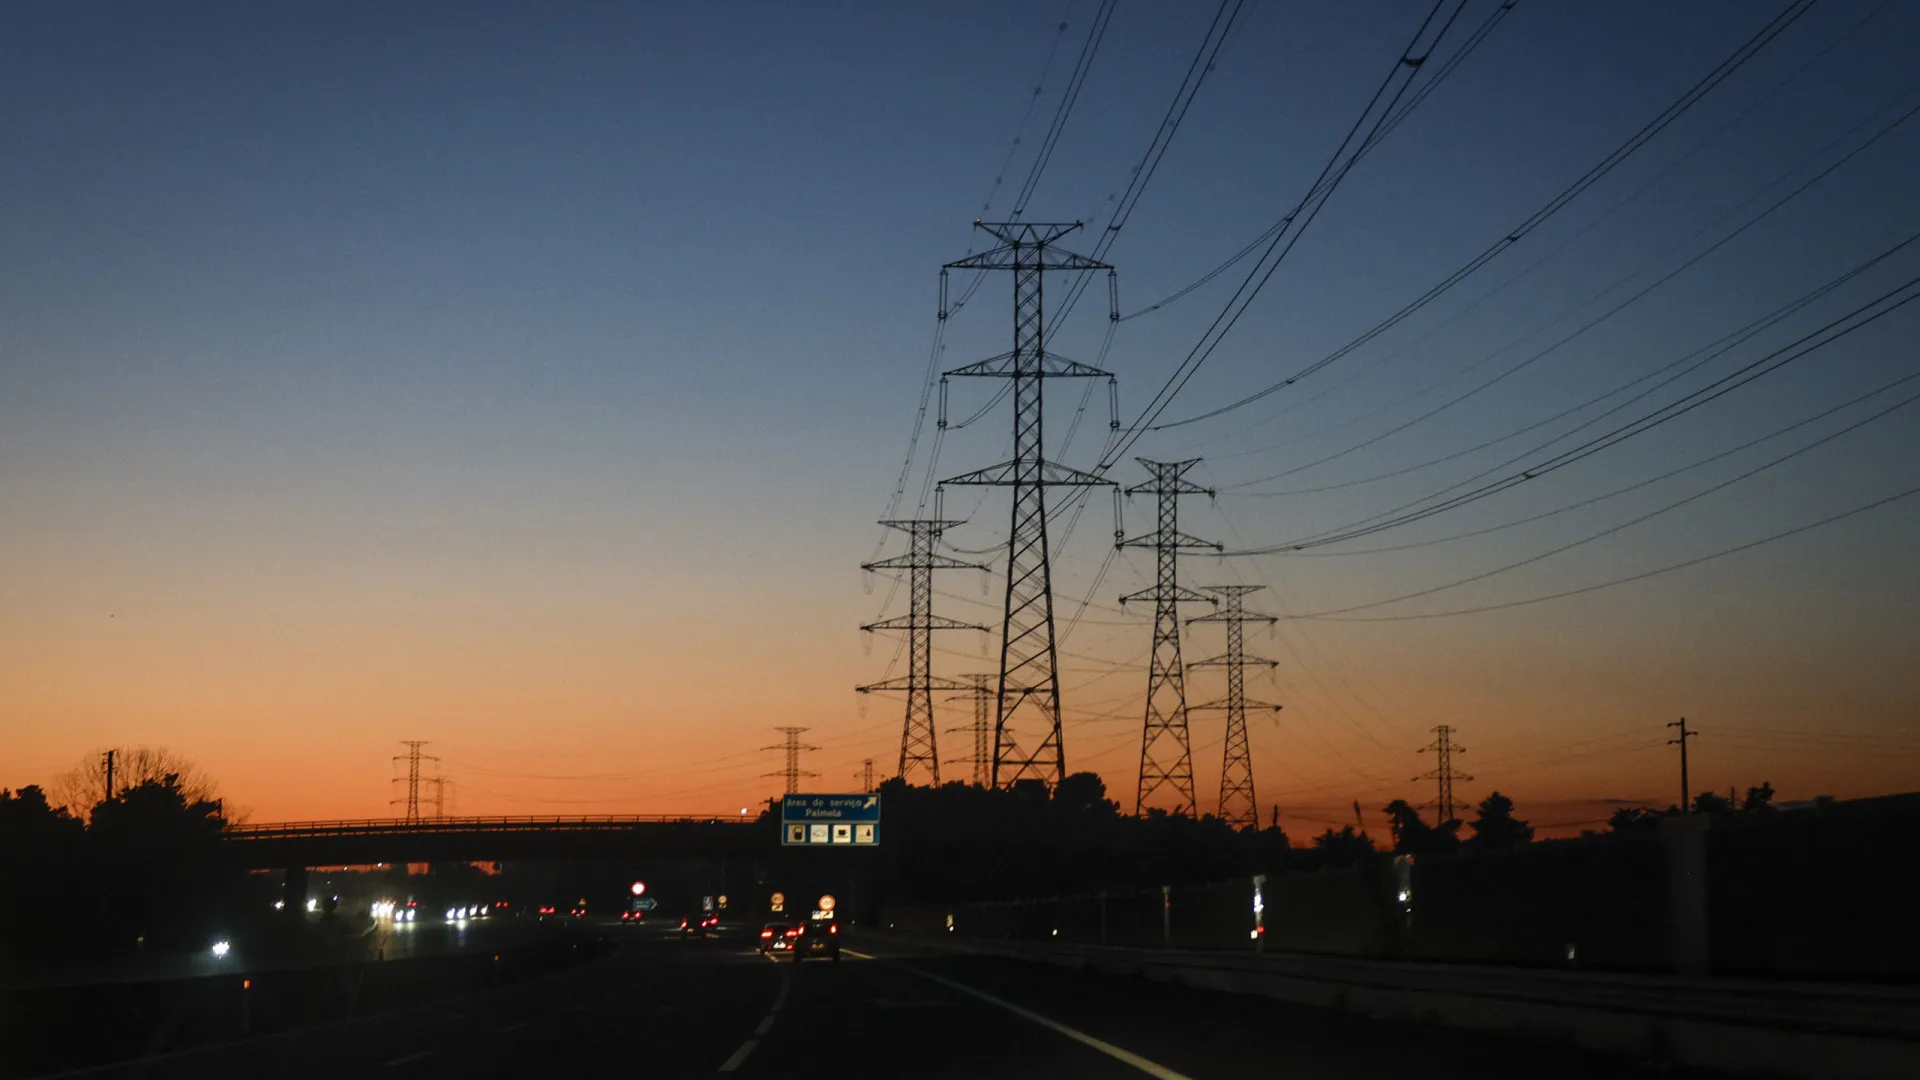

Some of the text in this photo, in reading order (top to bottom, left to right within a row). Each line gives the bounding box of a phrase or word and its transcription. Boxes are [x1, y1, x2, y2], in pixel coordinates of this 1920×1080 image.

[812, 797, 824, 806] de
[829, 799, 862, 808] serviço
[805, 808, 842, 817] Palmela
